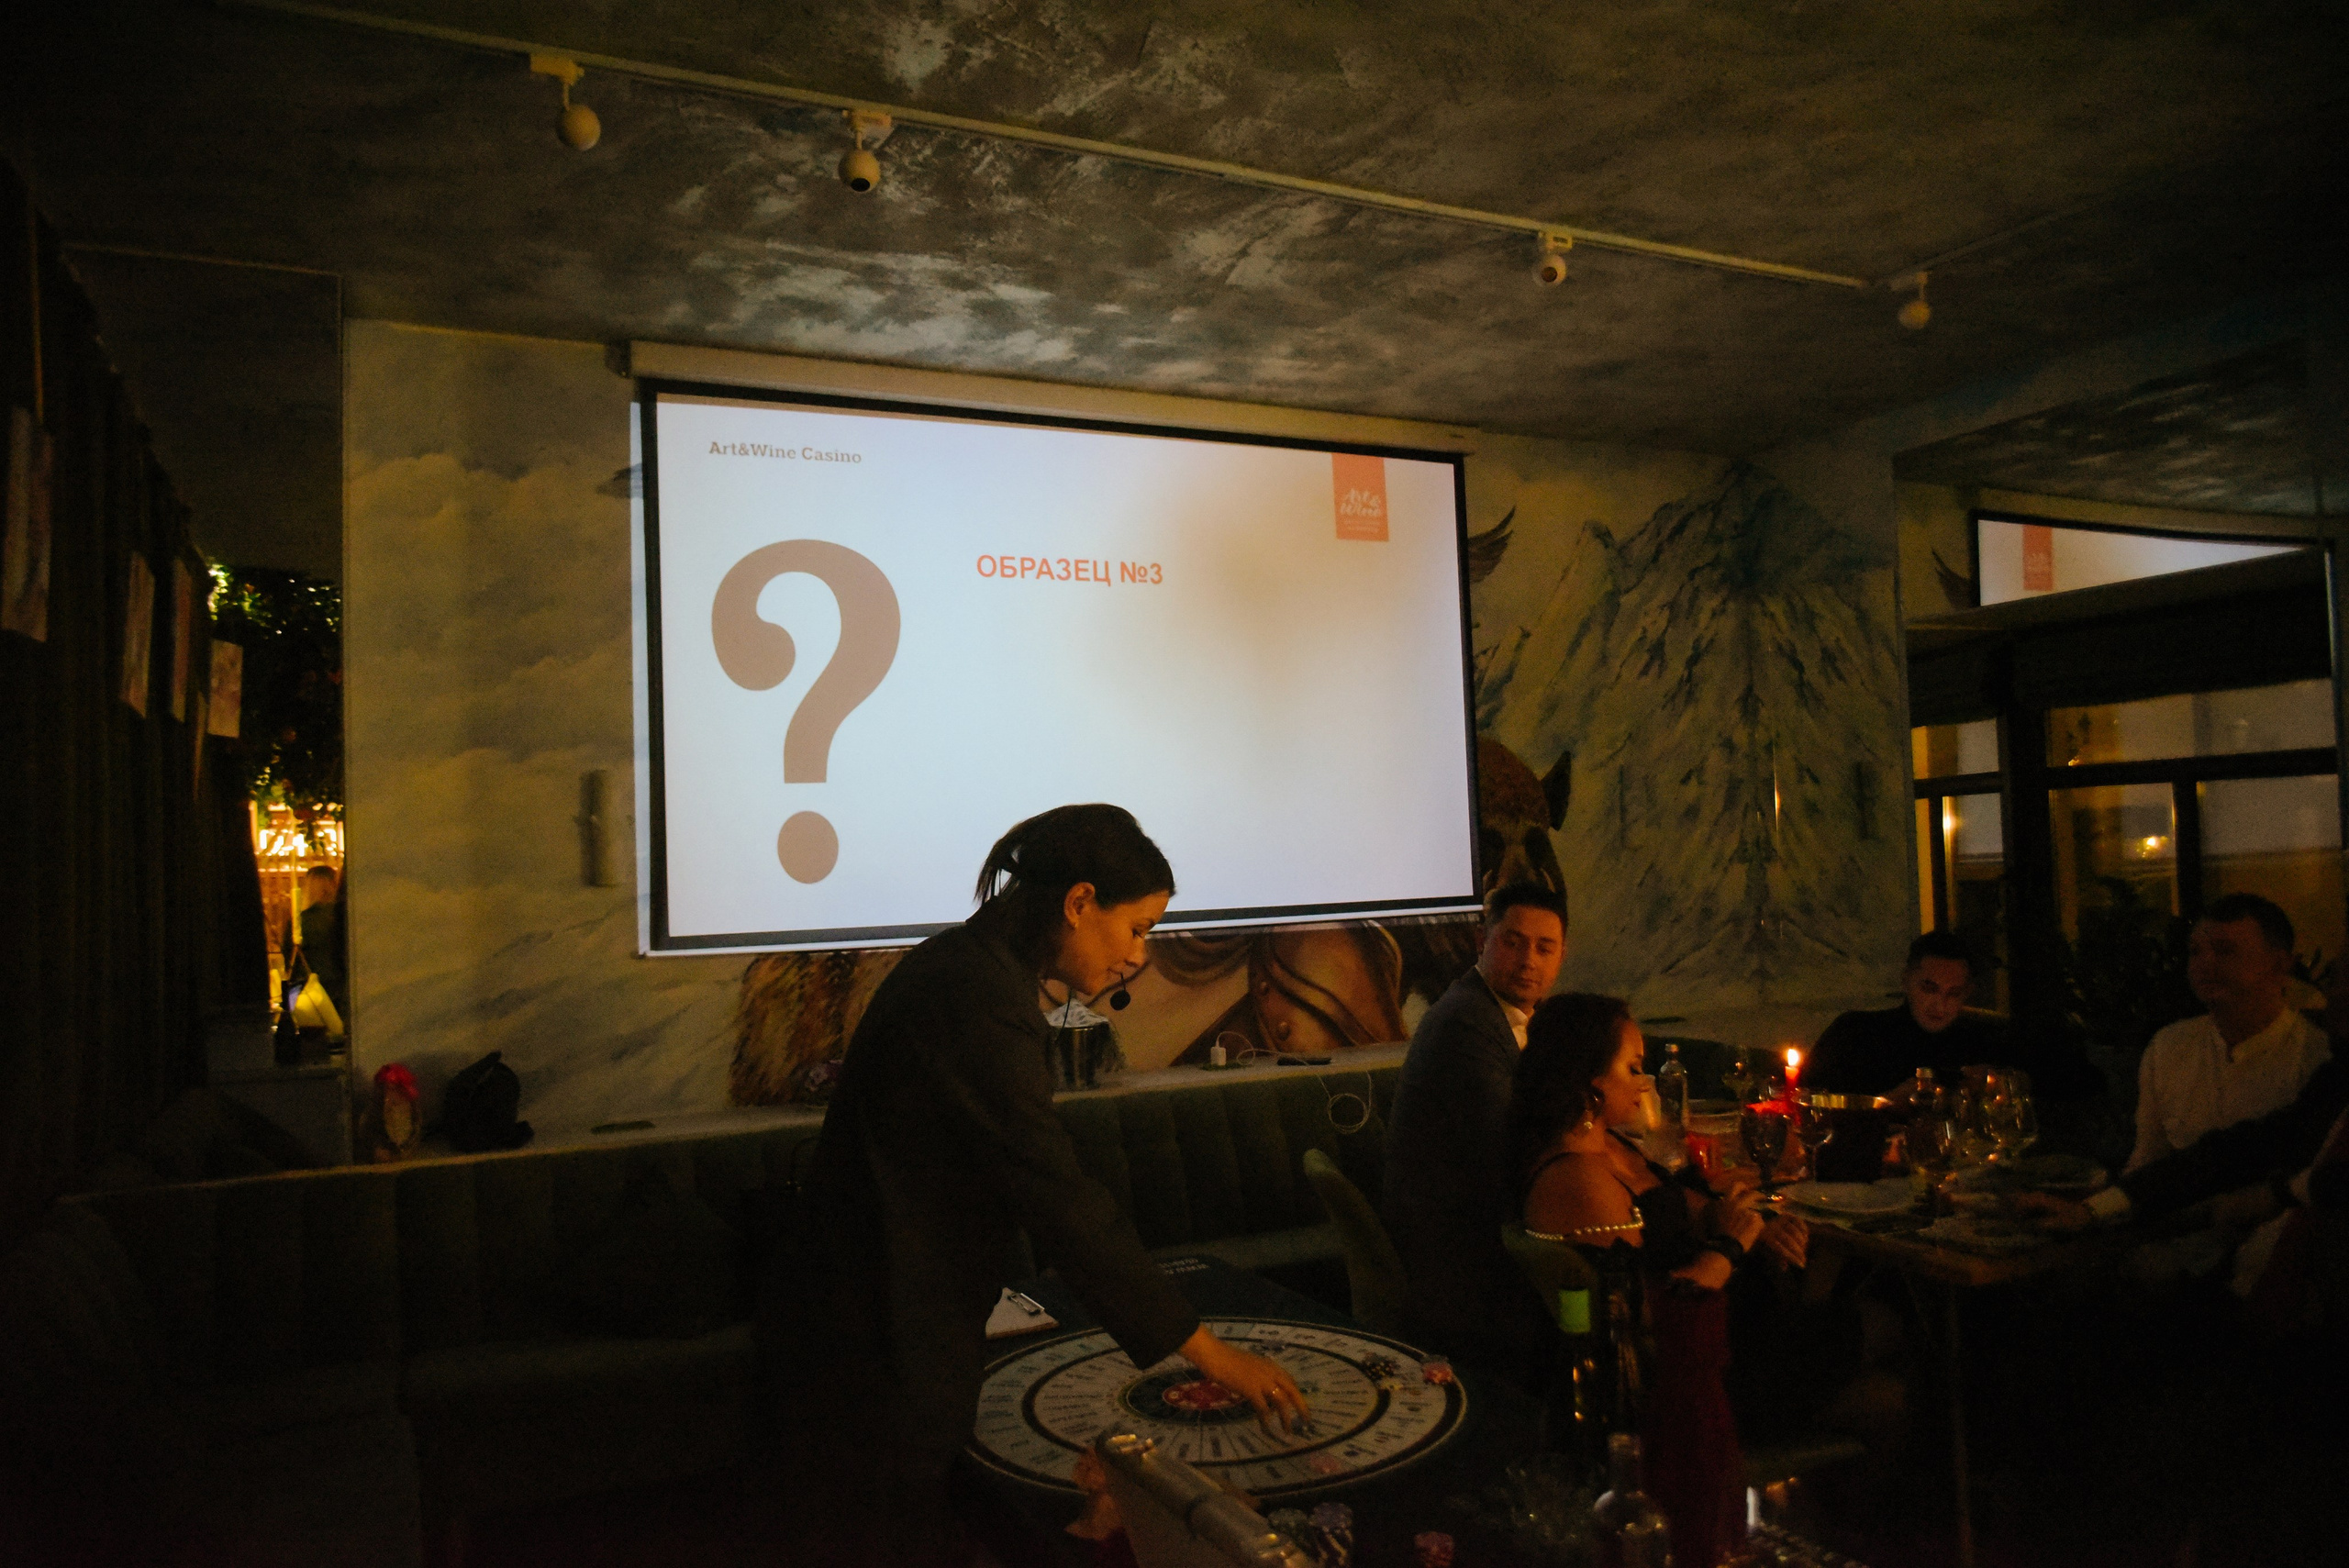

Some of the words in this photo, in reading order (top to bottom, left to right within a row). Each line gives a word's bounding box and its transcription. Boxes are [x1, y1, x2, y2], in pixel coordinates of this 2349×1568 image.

[708, 440, 796, 460] Art&Wine
[801, 446, 863, 464] Casino
[975, 553, 1112, 587] ОБРАЗЕЦ
[1119, 561, 1163, 585] №3
